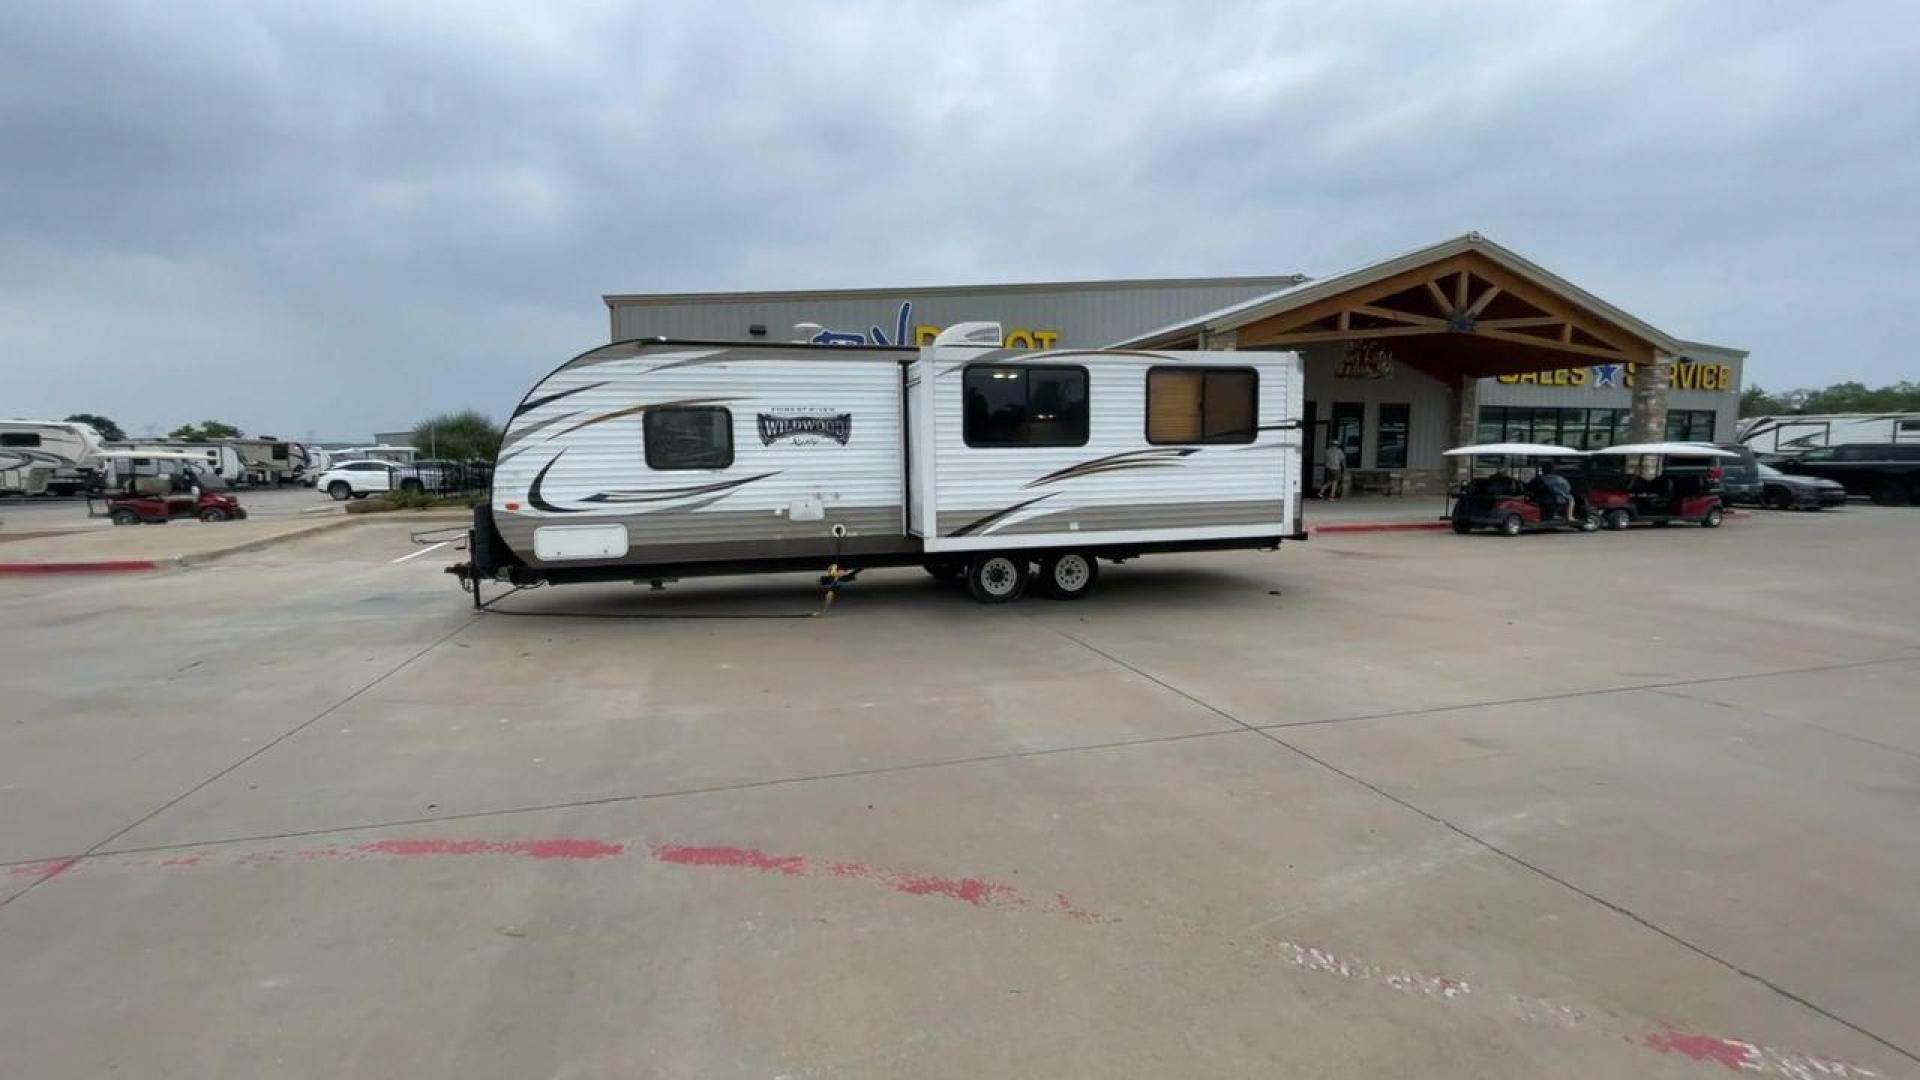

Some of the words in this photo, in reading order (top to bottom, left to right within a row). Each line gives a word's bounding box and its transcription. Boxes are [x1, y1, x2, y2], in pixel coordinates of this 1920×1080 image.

[914, 324, 1057, 349] DOT
[1623, 362, 1730, 390] SRVICE
[764, 418, 846, 437] WILDWOOD
